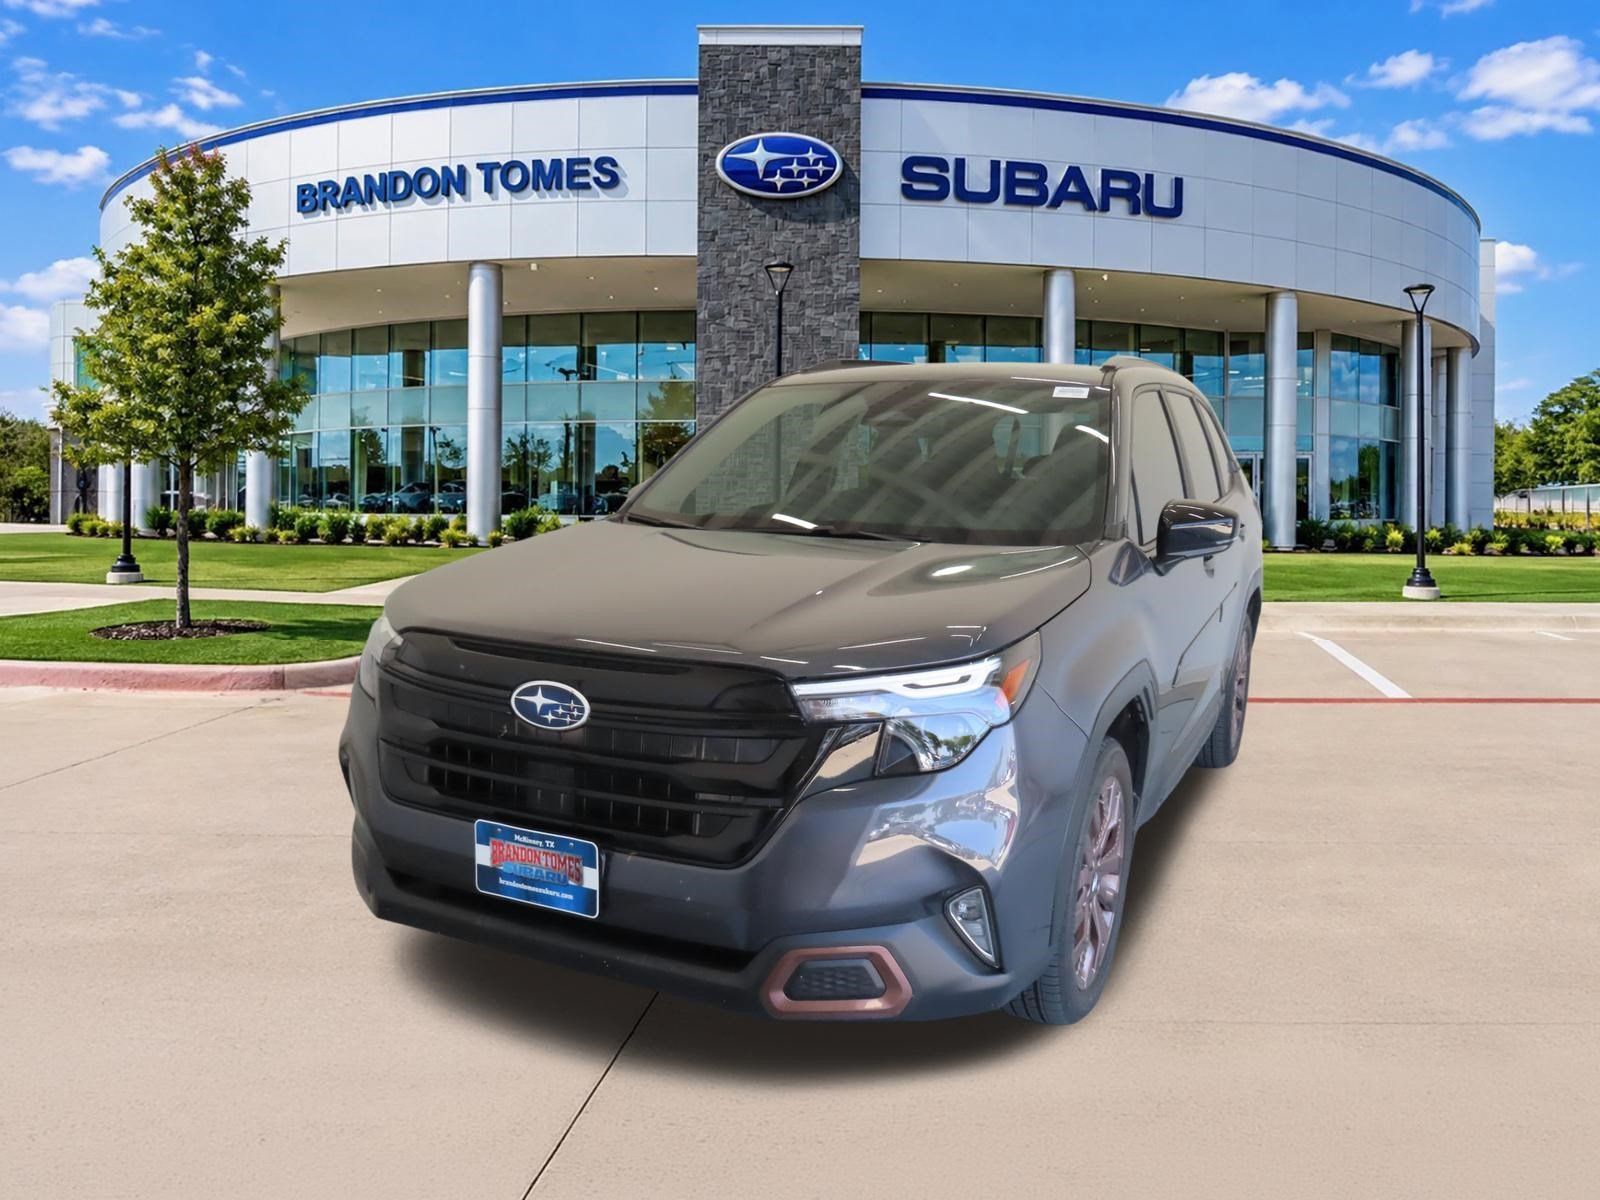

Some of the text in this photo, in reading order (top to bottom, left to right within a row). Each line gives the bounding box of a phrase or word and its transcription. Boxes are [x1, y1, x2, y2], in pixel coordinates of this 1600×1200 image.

[296, 156, 621, 213] BRANDON TOMES
[901, 155, 1183, 218] SUBARU
[490, 839, 583, 885] BRANDON TOMES
[545, 840, 555, 848] TX
[502, 862, 569, 885] SUBARU
